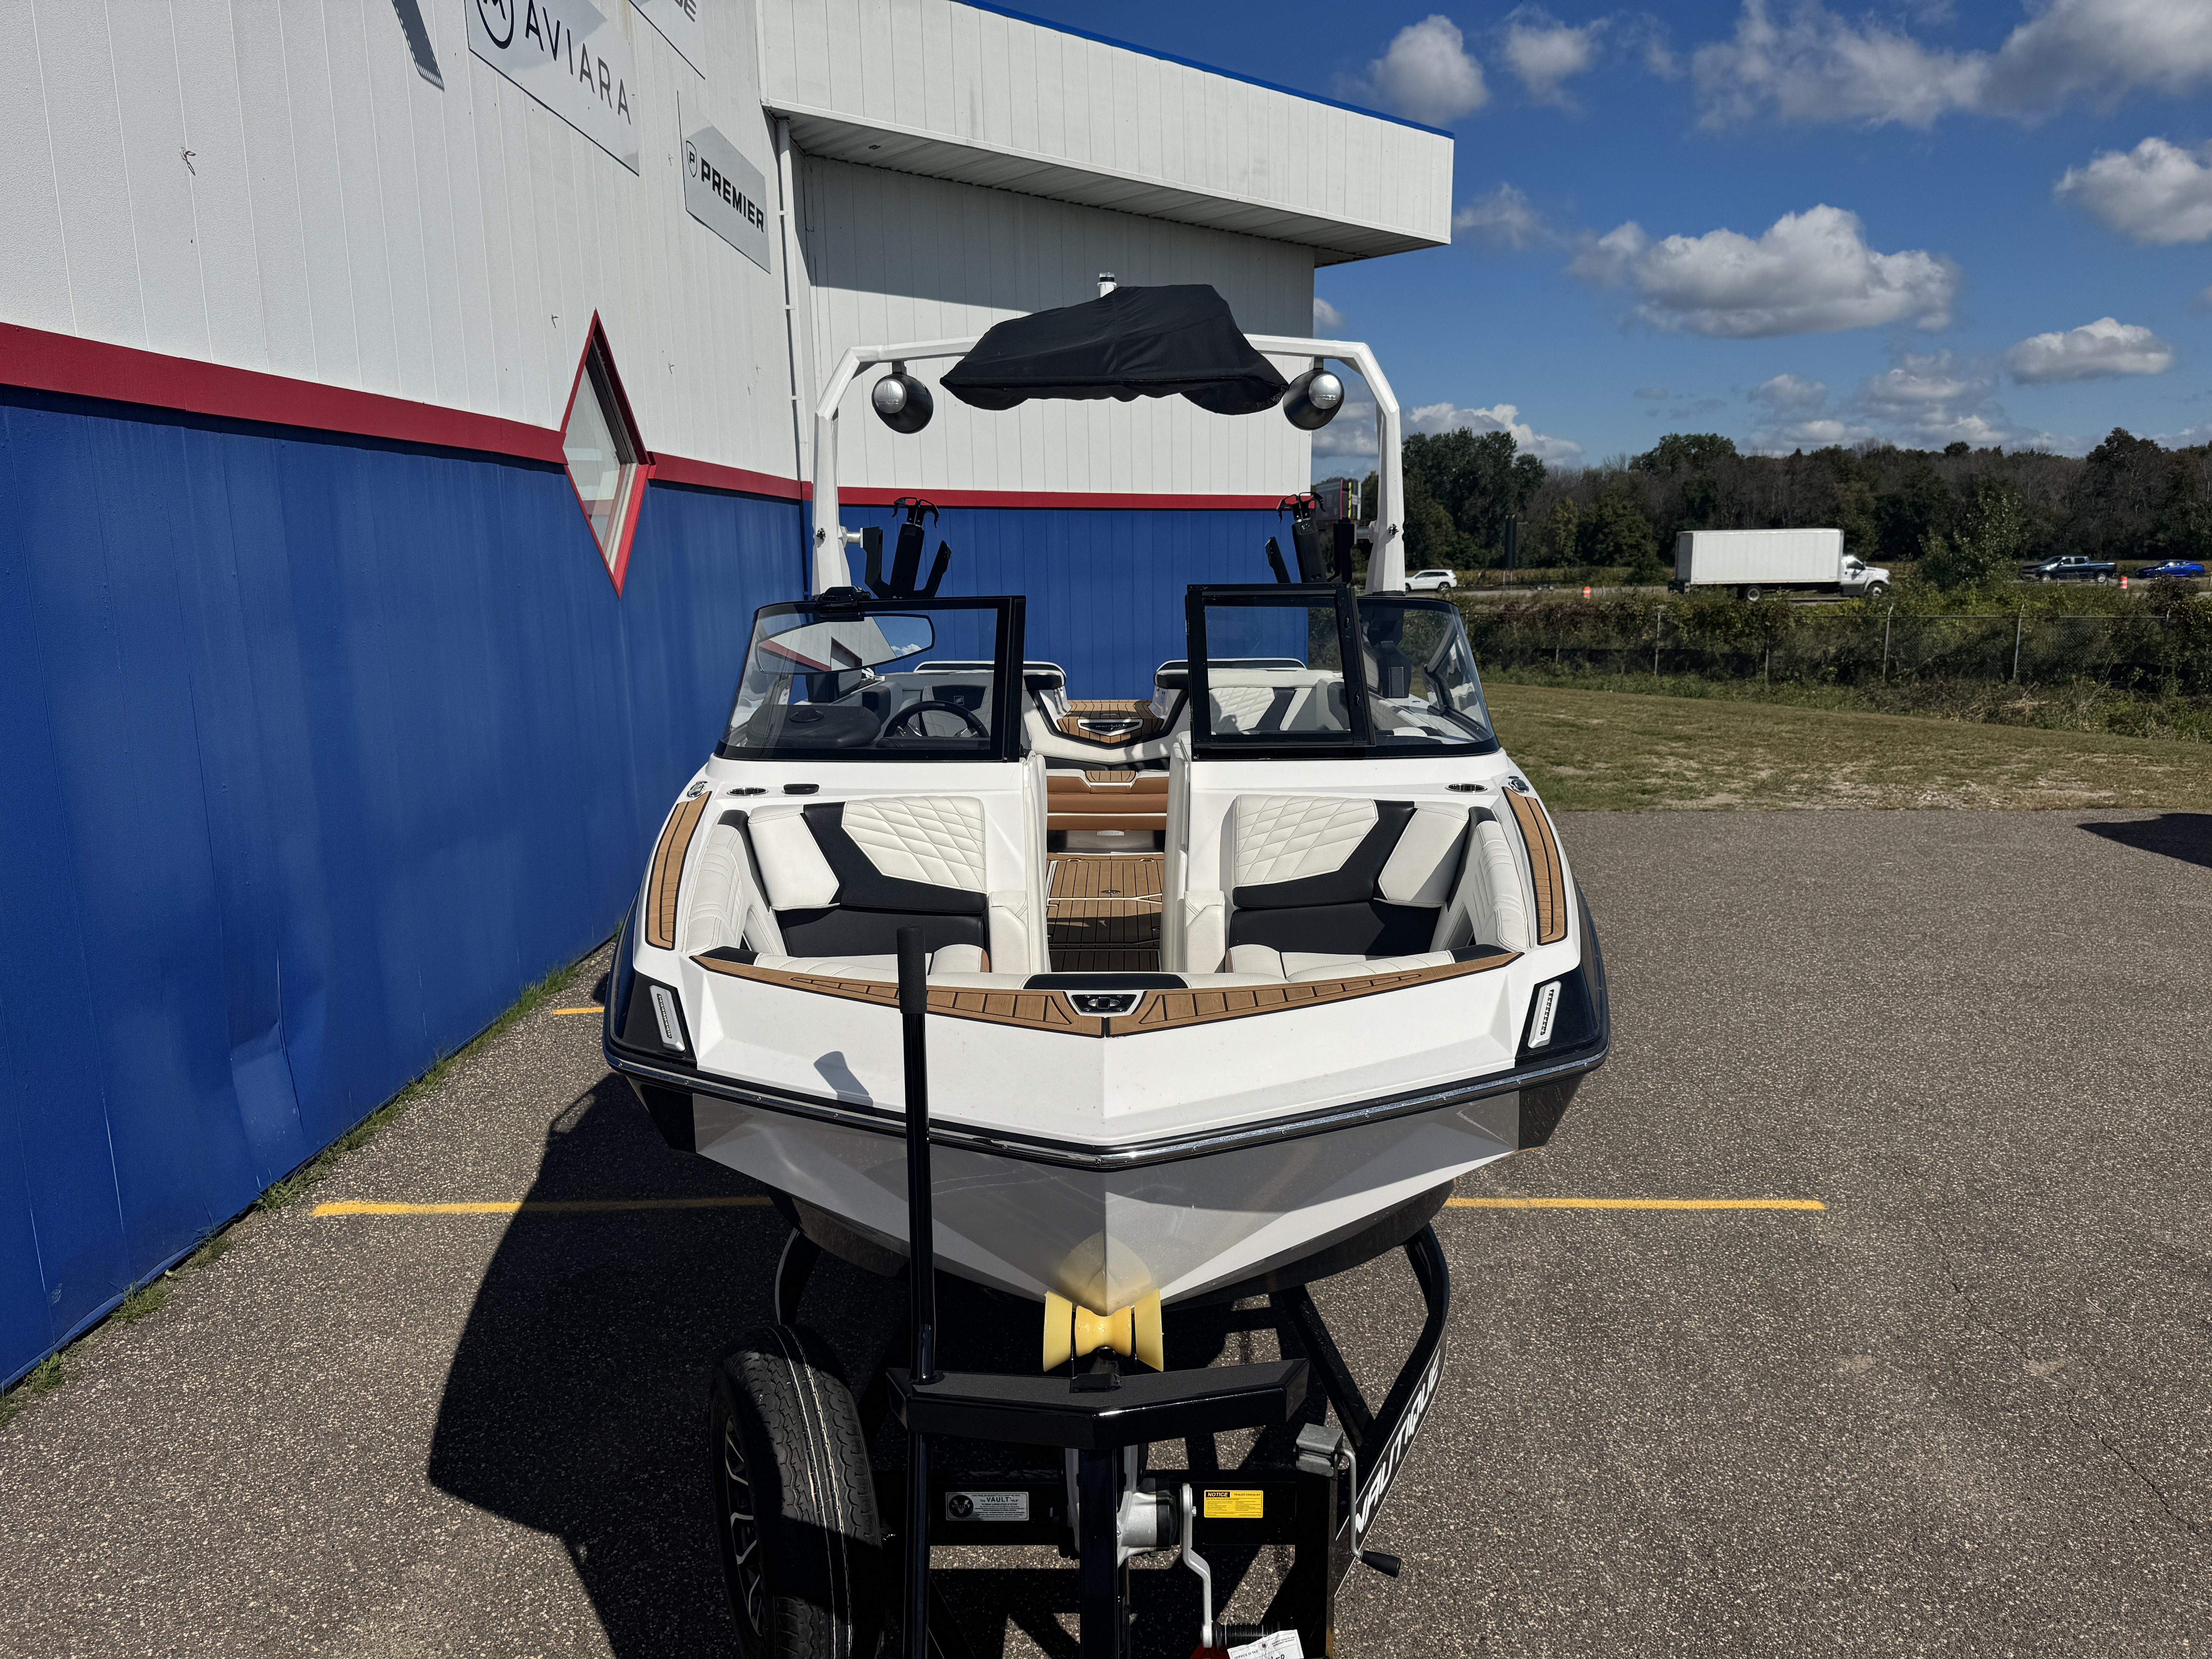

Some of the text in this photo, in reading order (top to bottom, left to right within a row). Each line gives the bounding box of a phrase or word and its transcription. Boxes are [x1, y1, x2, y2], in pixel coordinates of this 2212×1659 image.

[526, 0, 631, 125] AVIARA
[701, 157, 764, 234] PREMIER
[1355, 1348, 1440, 1534] NAUTIQUE
